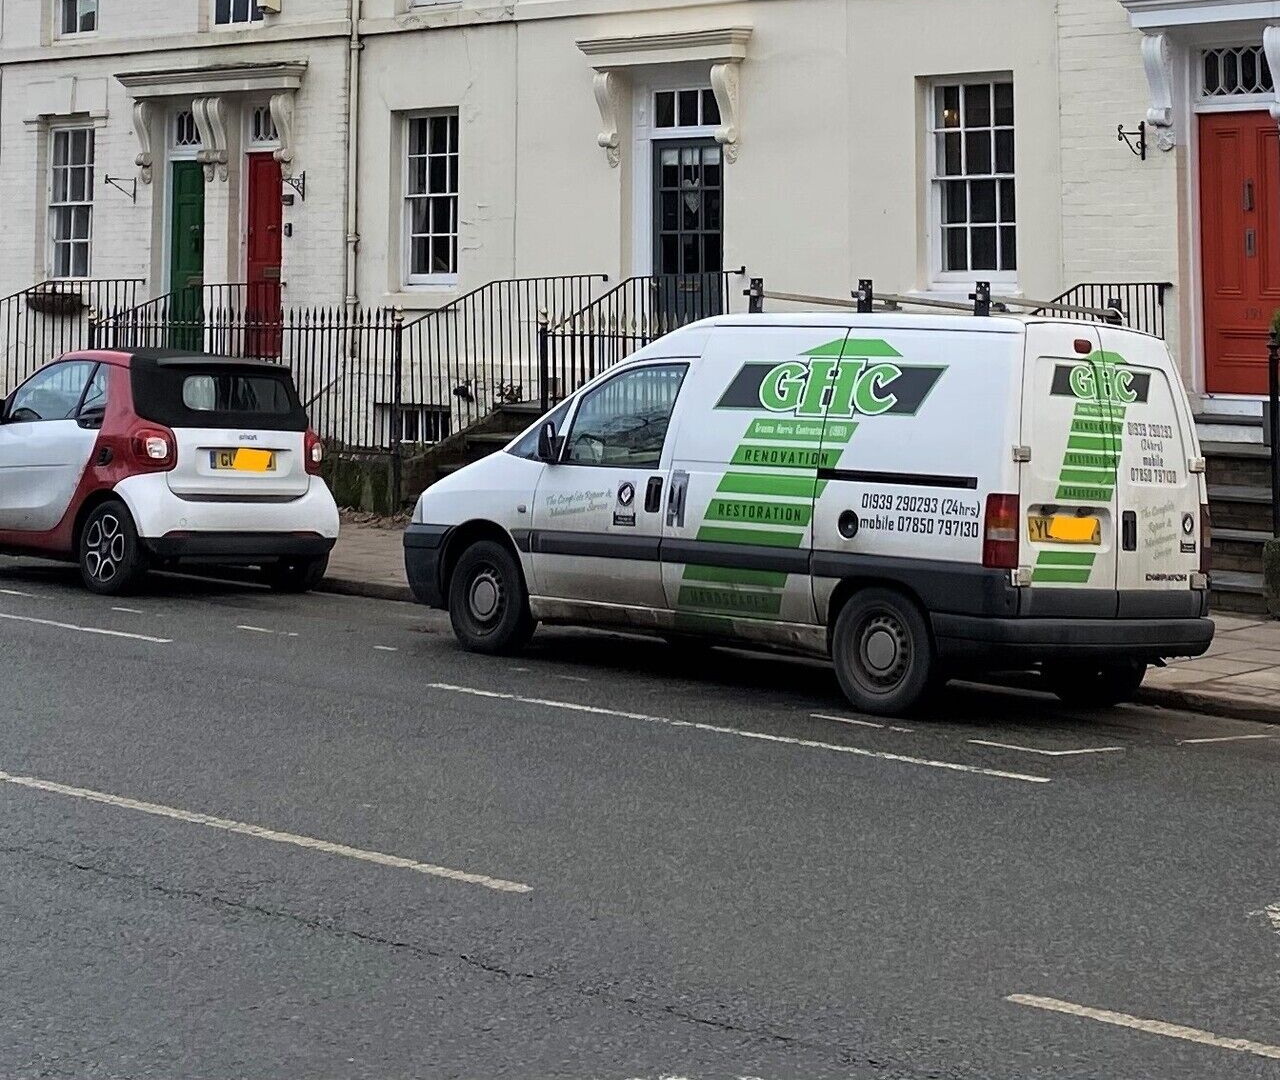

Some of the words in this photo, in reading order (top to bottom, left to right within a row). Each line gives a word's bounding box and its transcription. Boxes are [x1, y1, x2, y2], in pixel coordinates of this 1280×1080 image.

[758, 357, 903, 419] GHC
[1070, 363, 1138, 403] GHC
[744, 448, 829, 466] RENOVATION
[718, 503, 802, 521] RESTORATION
[861, 493, 893, 510] 01939
[895, 495, 939, 513] 290293
[941, 498, 981, 518] (24hrs)
[860, 514, 894, 531] mobile
[897, 515, 934, 534] 07850
[937, 518, 979, 538] 797130
